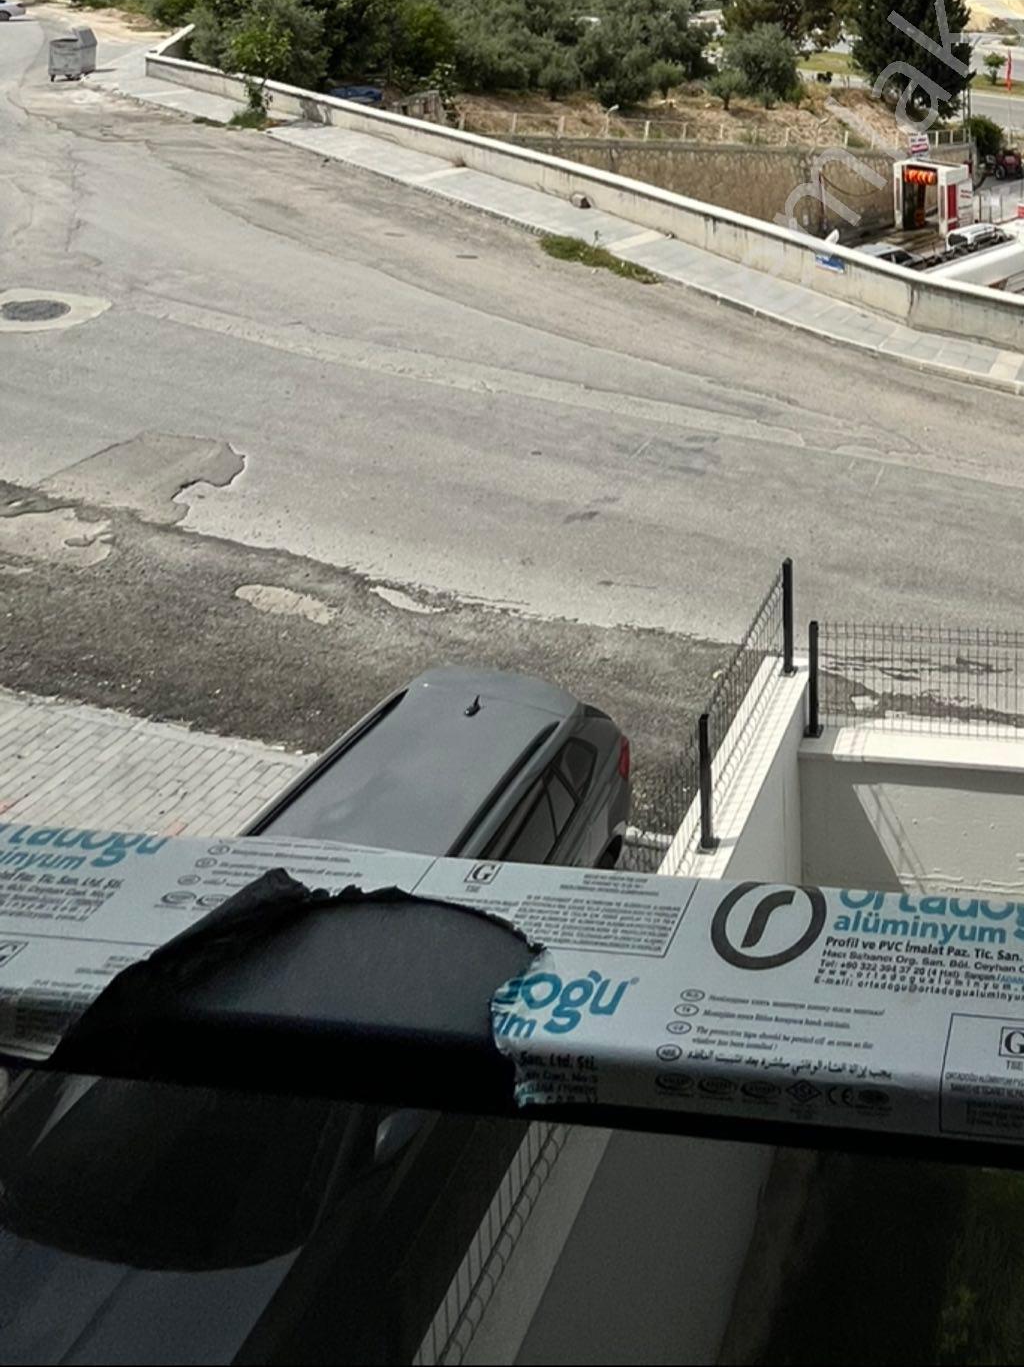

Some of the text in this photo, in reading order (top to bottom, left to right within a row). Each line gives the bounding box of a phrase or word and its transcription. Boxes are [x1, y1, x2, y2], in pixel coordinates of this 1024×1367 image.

[471, 863, 495, 882] G
[833, 910, 1006, 945] alüminyum
[825, 936, 859, 949] Profil
[862, 940, 876, 950] ve
[879, 940, 903, 953] PVC
[905, 940, 943, 955] İmalat
[947, 946, 970, 958] Paz.
[974, 948, 993, 960] Tic.
[997, 950, 1022, 962] San.
